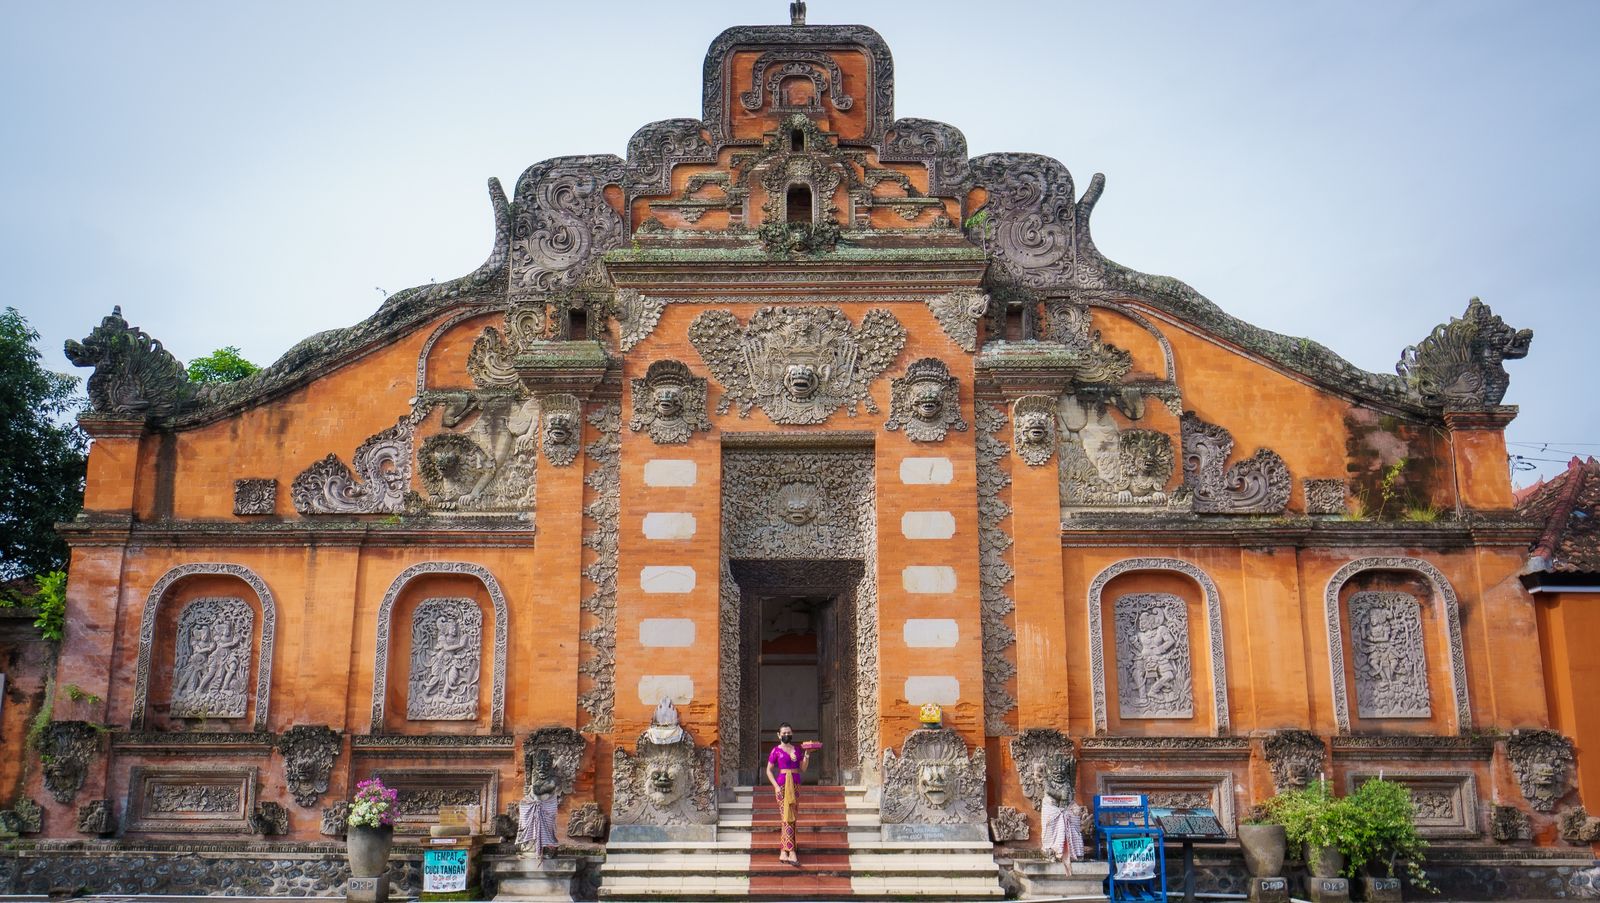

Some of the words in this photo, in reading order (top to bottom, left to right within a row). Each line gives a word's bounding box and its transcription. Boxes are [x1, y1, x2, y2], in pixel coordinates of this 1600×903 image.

[1121, 840, 1144, 850] TEMPAT
[433, 851, 458, 861] TEMPAT
[1129, 851, 1154, 862] TANGAN
[425, 865, 439, 875] CUCI
[441, 865, 466, 874] TANGAN
[351, 880, 373, 890] DKP
[1323, 882, 1345, 891] DKP
